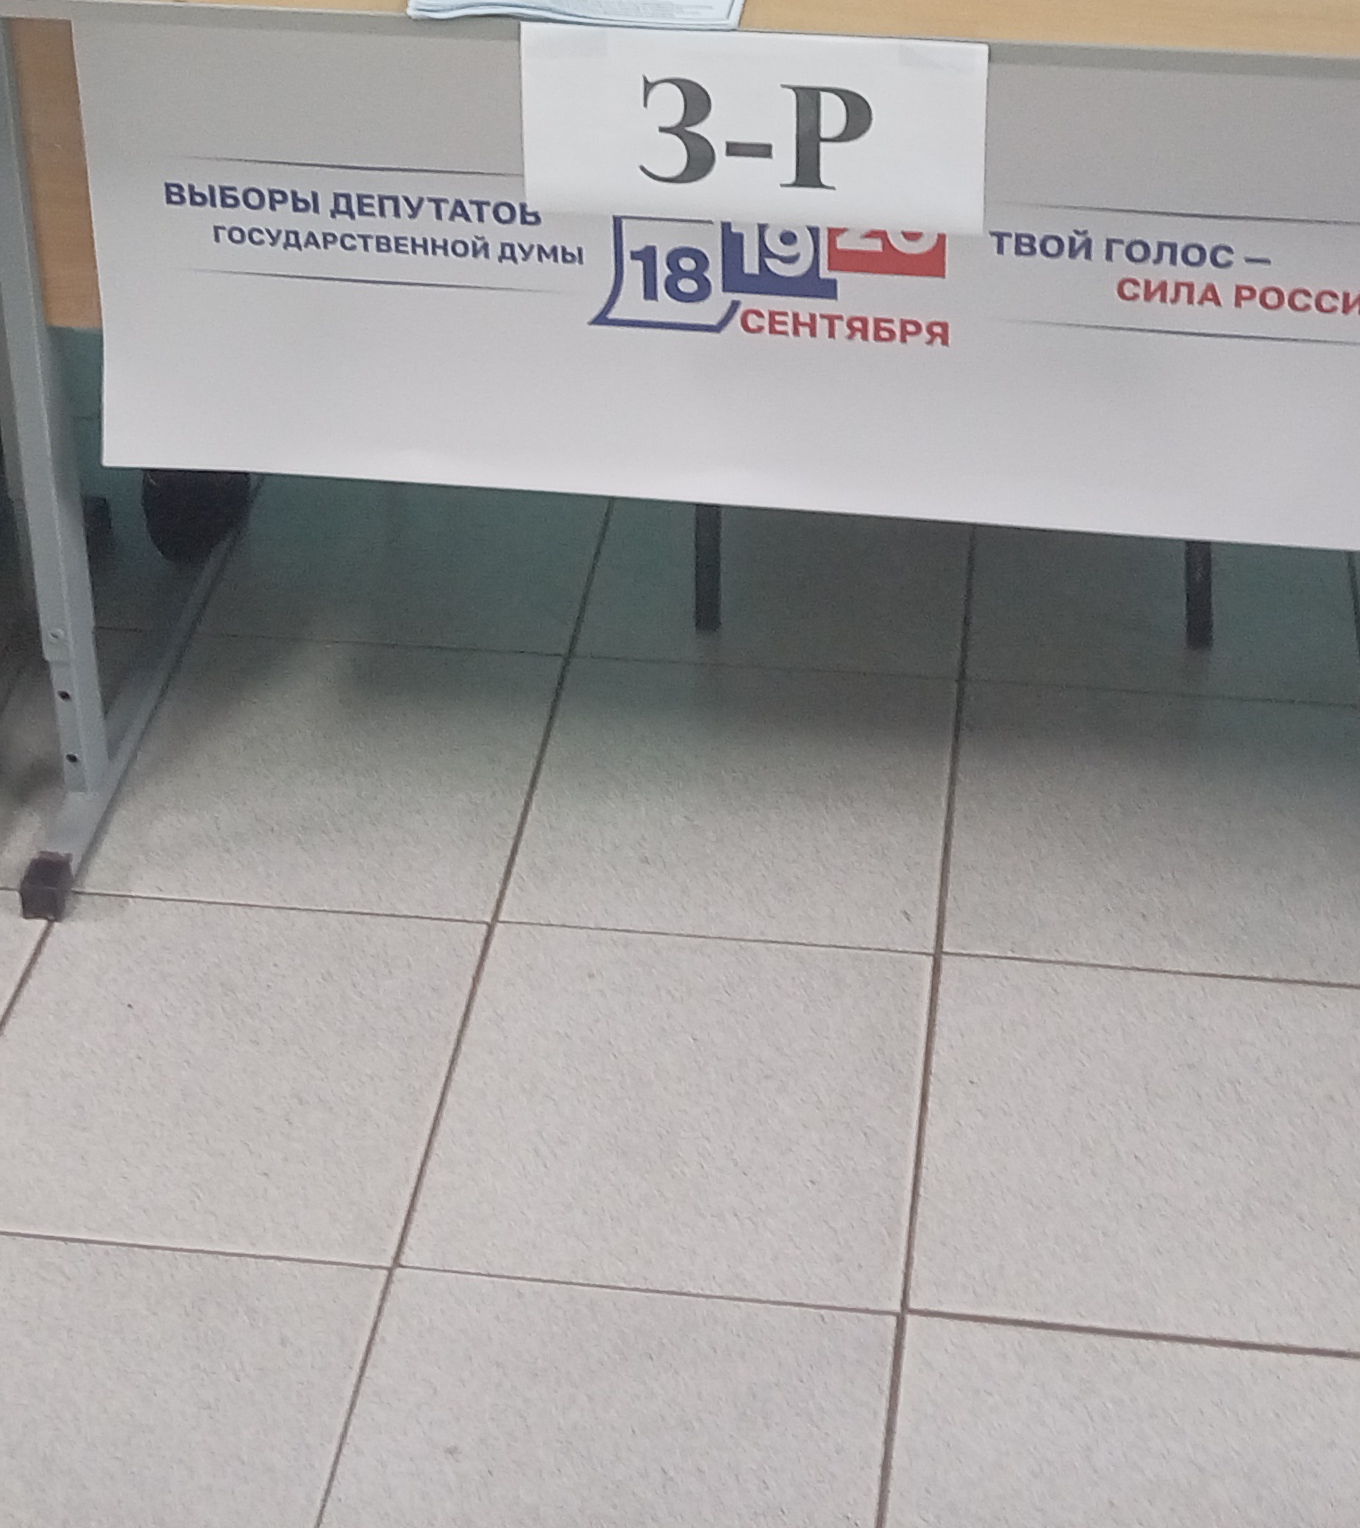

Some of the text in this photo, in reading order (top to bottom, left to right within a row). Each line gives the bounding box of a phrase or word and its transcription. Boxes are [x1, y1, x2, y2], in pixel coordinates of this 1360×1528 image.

[639, 75, 873, 191] З-Р
[163, 181, 320, 215] ВЫБОРЫ
[213, 224, 584, 265] ГОСУДАРСТВЕННОЙ ДУМЫ
[730, 223, 815, 278] 19
[988, 228, 1093, 262] ТВОЙ
[1104, 238, 1235, 270] ГОЛОС
[629, 244, 713, 304] 18
[1116, 277, 1222, 308] СИЛА
[740, 308, 950, 348] СЕНТЯБРЯ
